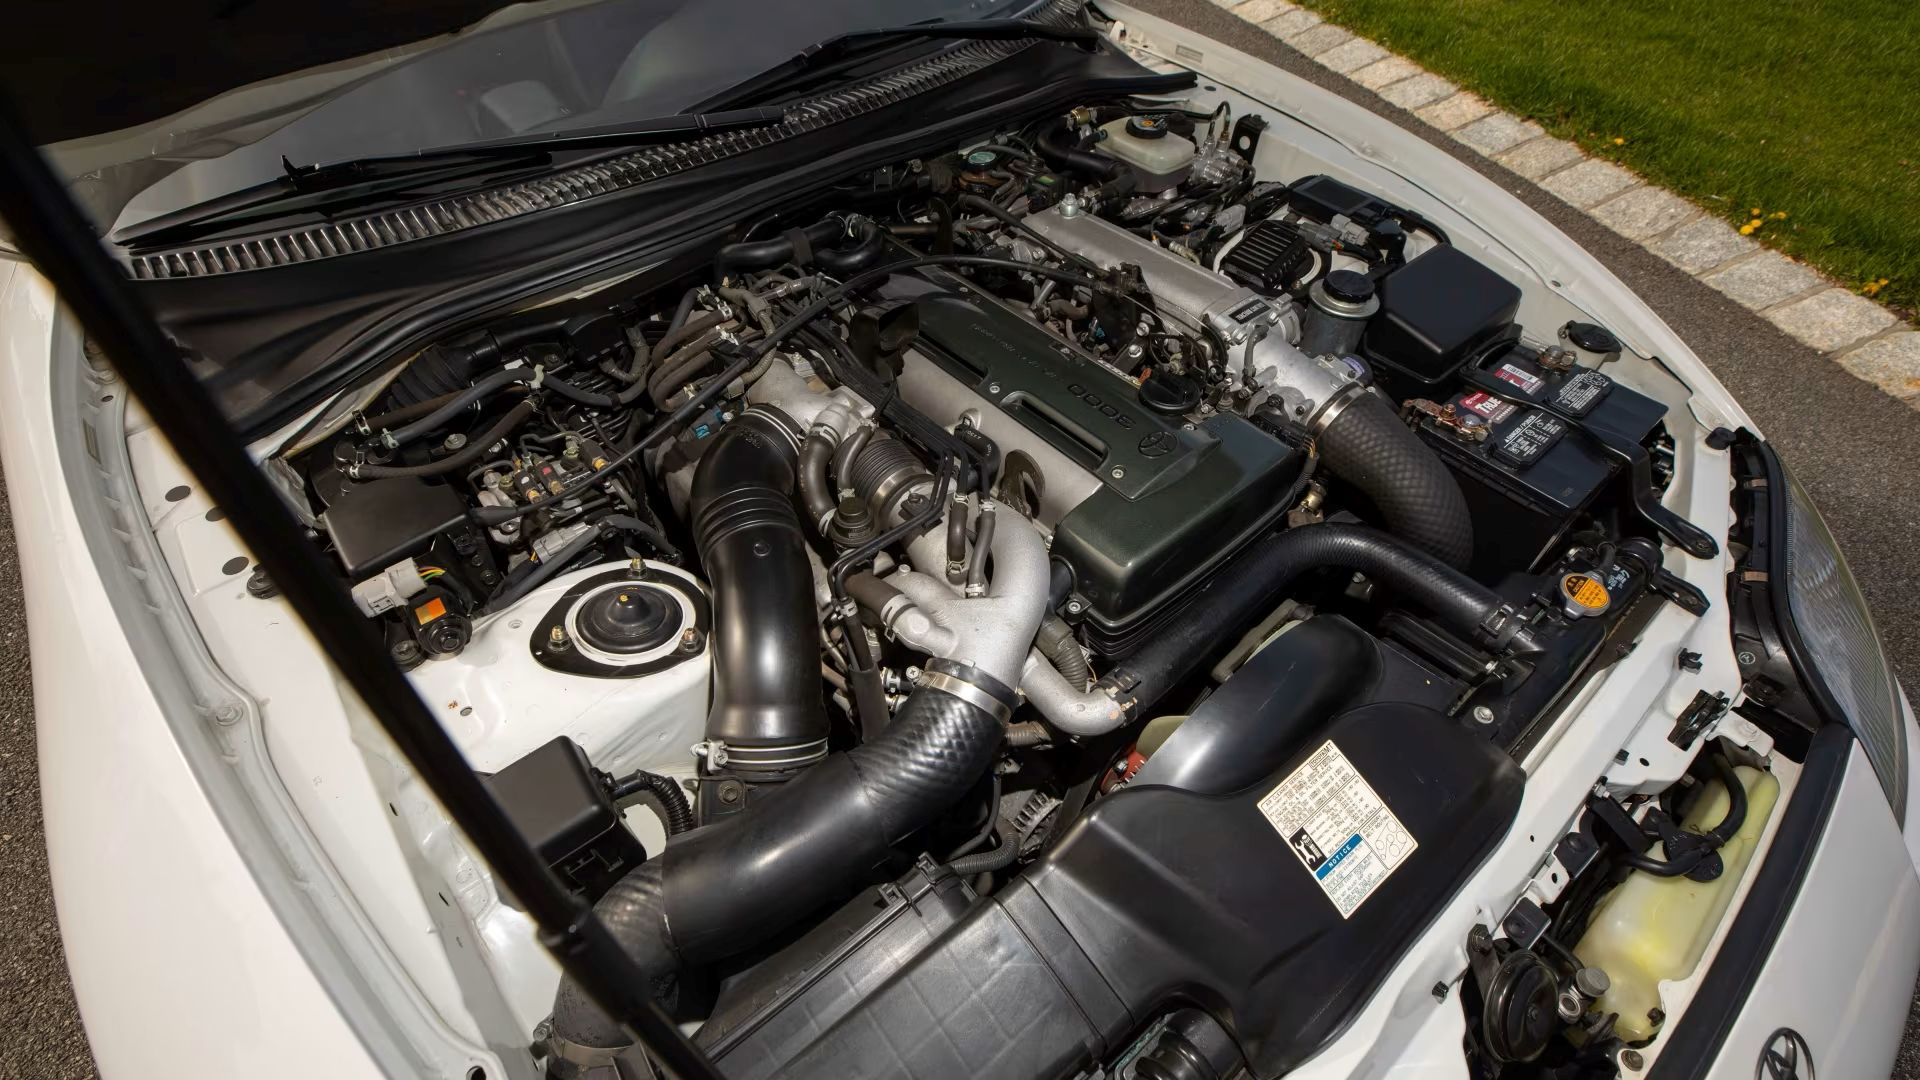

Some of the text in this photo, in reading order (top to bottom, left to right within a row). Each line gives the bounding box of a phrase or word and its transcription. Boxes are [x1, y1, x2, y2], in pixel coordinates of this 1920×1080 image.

[1066, 381, 1137, 431] 3000
[1475, 396, 1502, 413] TRUE
[1310, 742, 1334, 766] TOYOTA MT
[1265, 771, 1304, 807] AIR CLEANER SERVICE
[1328, 845, 1352, 868] NOTICE
